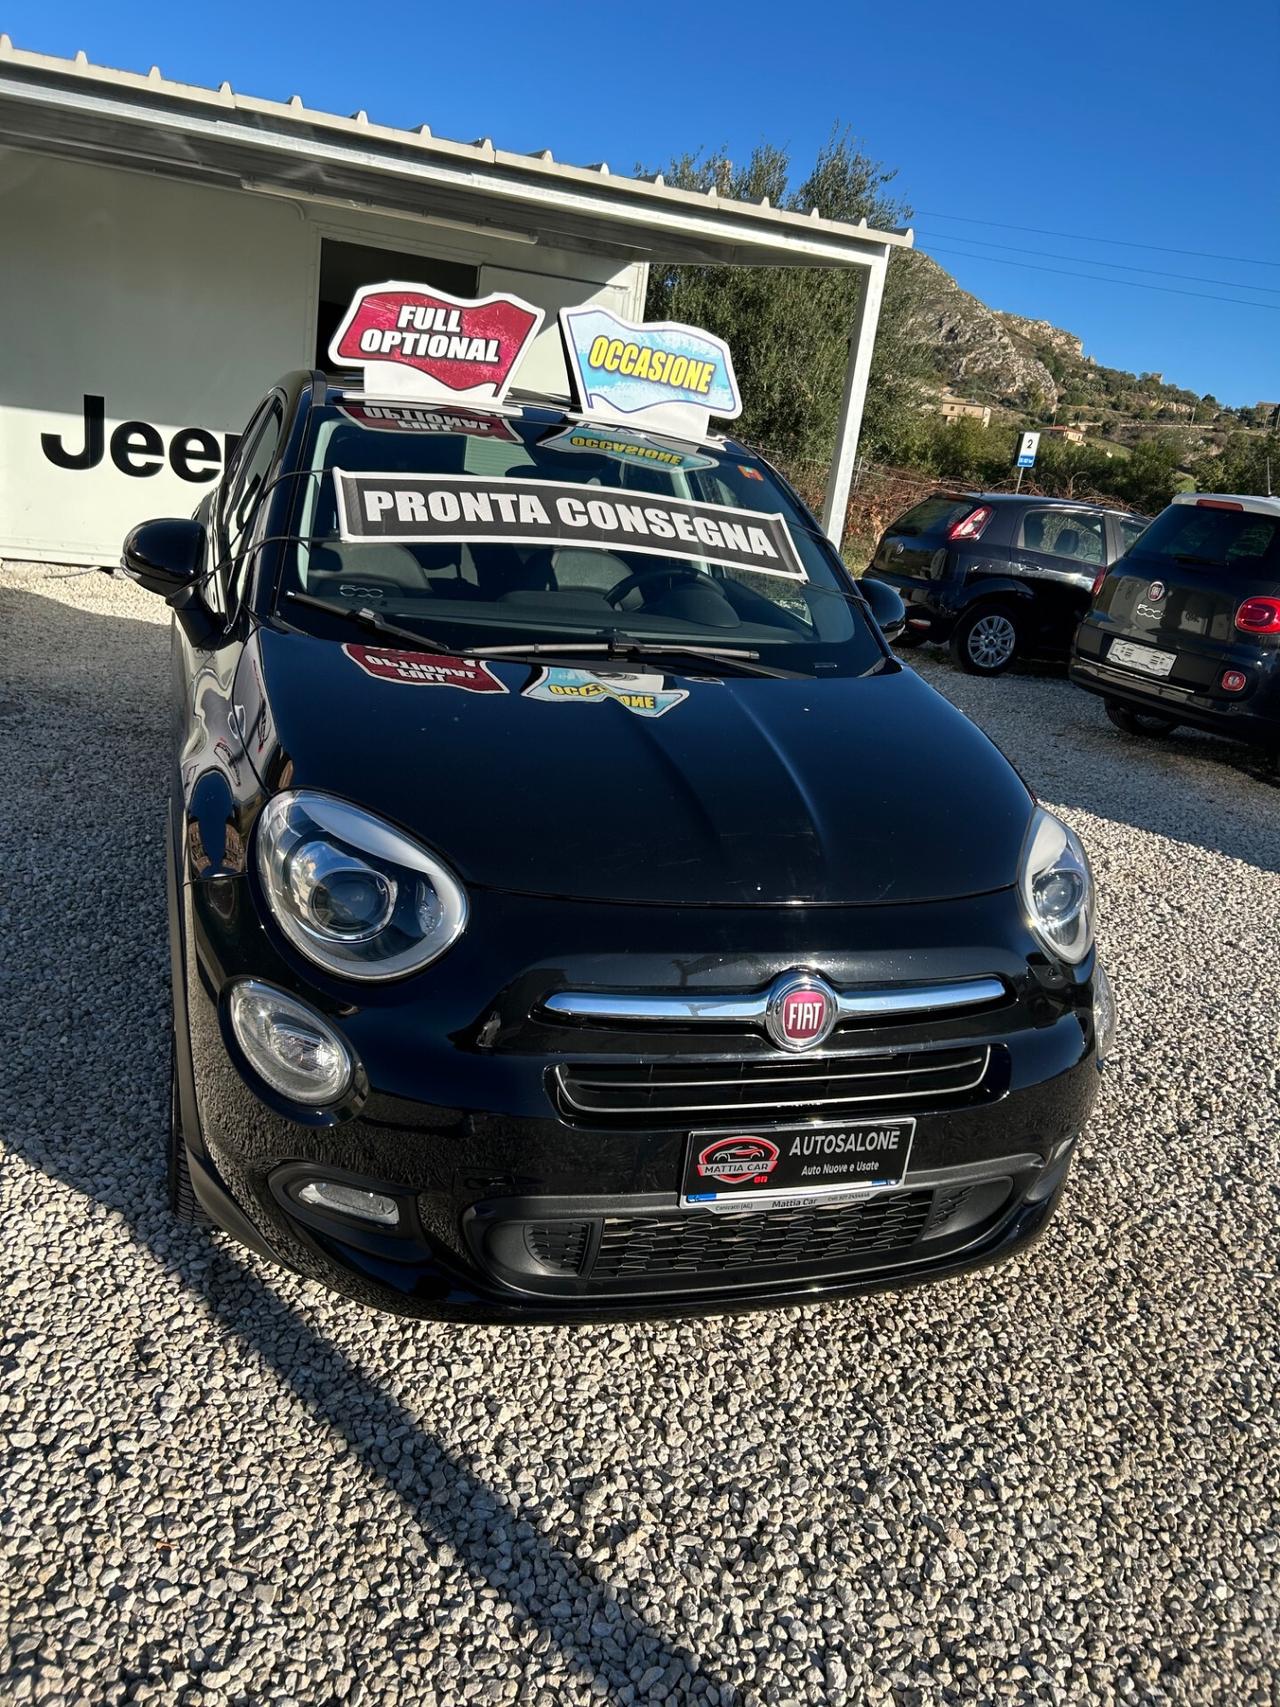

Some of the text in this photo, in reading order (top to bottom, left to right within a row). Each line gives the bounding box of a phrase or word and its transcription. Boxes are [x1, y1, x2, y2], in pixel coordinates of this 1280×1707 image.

[398, 305, 461, 334] FULL
[360, 330, 500, 363] OPTIONAL
[588, 336, 715, 395] OCCASIONE
[41, 394, 243, 483] Jee
[1027, 439, 1033, 448] 2
[363, 490, 779, 558] PRONTA CONSEGNA
[788, 1003, 822, 1030] FIAT
[789, 1131, 899, 1157] AUTOSALONE
[704, 1162, 769, 1174] MATTIA CAR
[801, 1160, 879, 1176] Auto Nuove e Usate
[771, 1198, 817, 1209] Mattia Car
